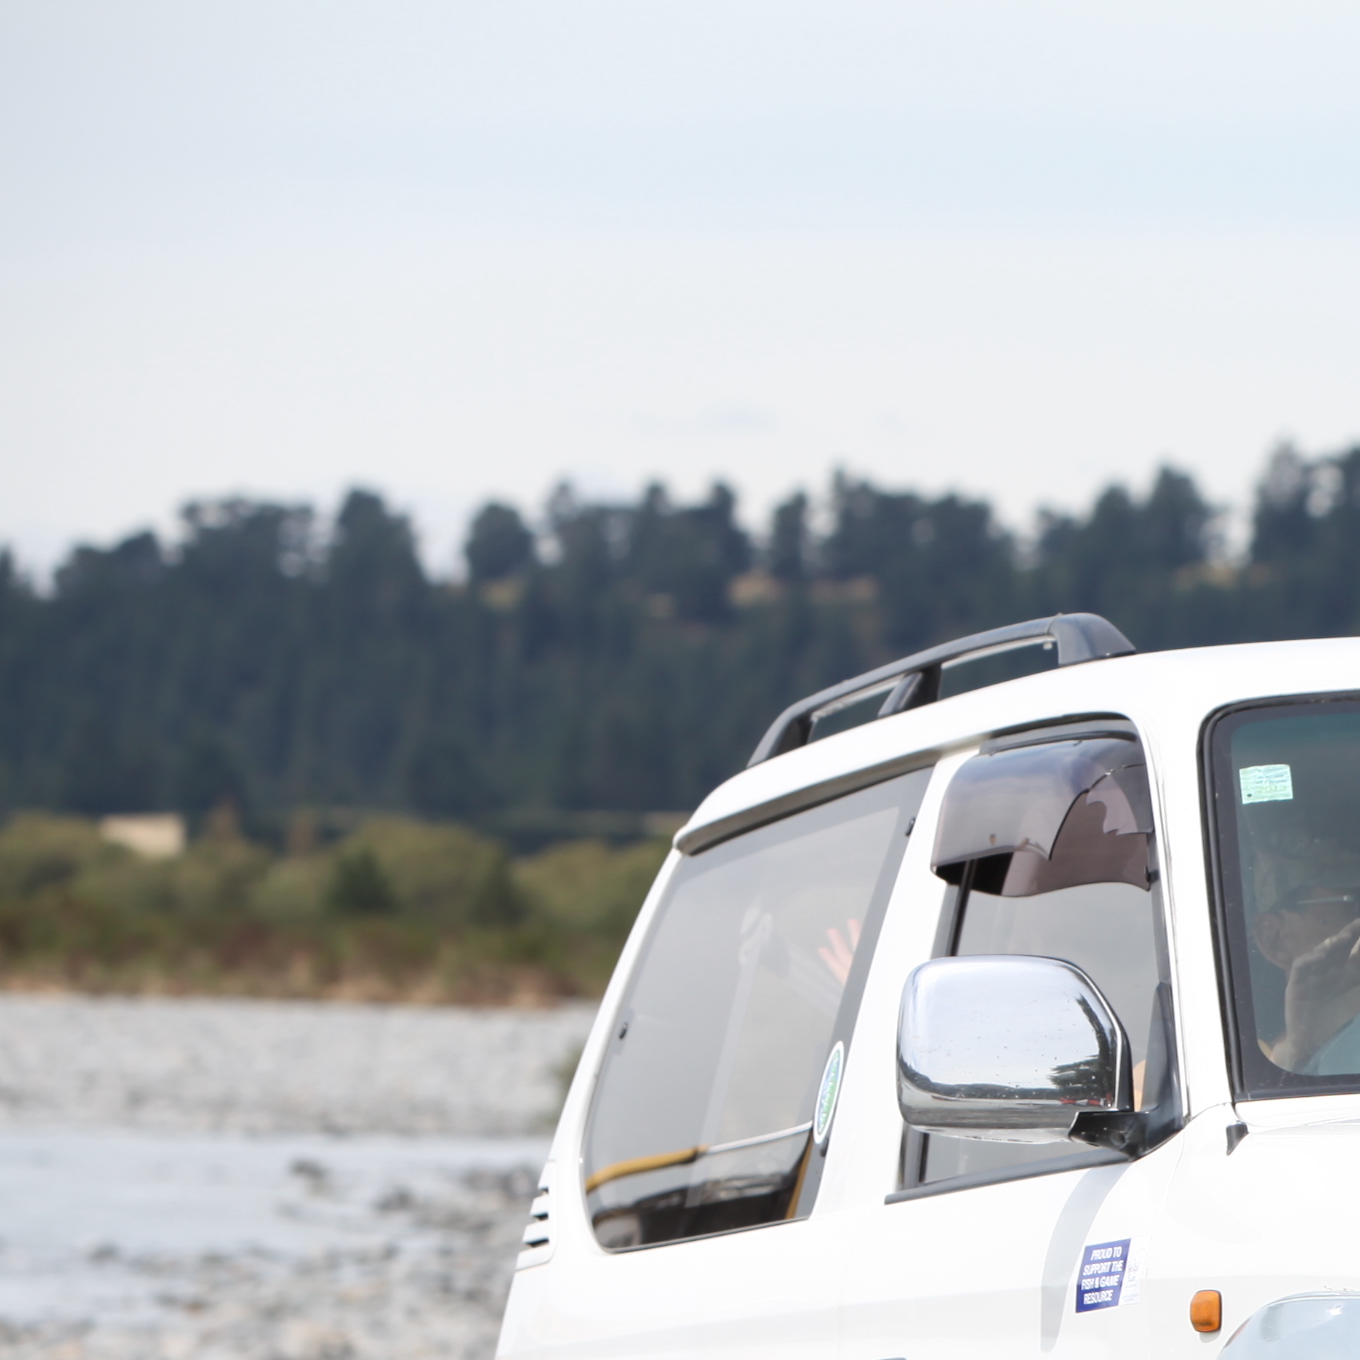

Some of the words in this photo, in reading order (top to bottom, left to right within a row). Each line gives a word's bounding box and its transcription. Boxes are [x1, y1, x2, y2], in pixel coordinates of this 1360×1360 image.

[1090, 1249, 1112, 1260] PROUD
[1112, 1246, 1122, 1258] TO
[1083, 1262, 1111, 1276] SUPPORT
[1111, 1260, 1124, 1272] THE
[1081, 1277, 1094, 1290] FISH
[1099, 1275, 1120, 1288] GAME
[1083, 1289, 1114, 1304] RESOURCE
